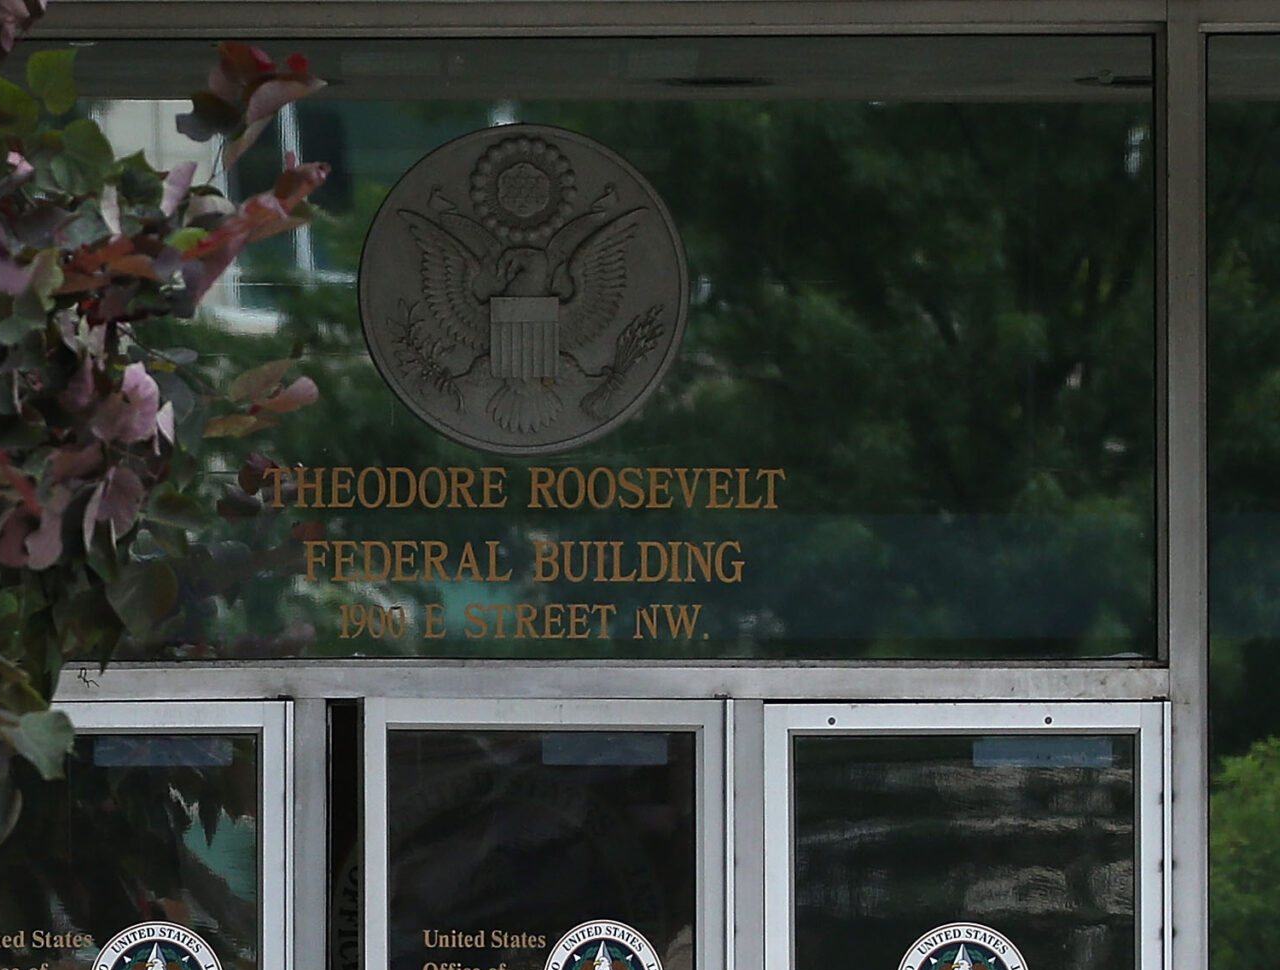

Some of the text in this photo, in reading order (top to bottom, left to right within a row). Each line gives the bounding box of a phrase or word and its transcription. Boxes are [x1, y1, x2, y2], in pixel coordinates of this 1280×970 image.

[263, 467, 786, 509] THEODORE ROOSEVELT
[304, 540, 745, 583] FEDERAL BUILDING
[339, 603, 710, 640] 1900 E STREET NW.
[32, 930, 94, 948] States
[110, 928, 202, 954] UNITED STATES
[423, 930, 546, 948] United States
[562, 926, 644, 952] UNITED STATES
[918, 929, 1009, 955] UNITED STATES
